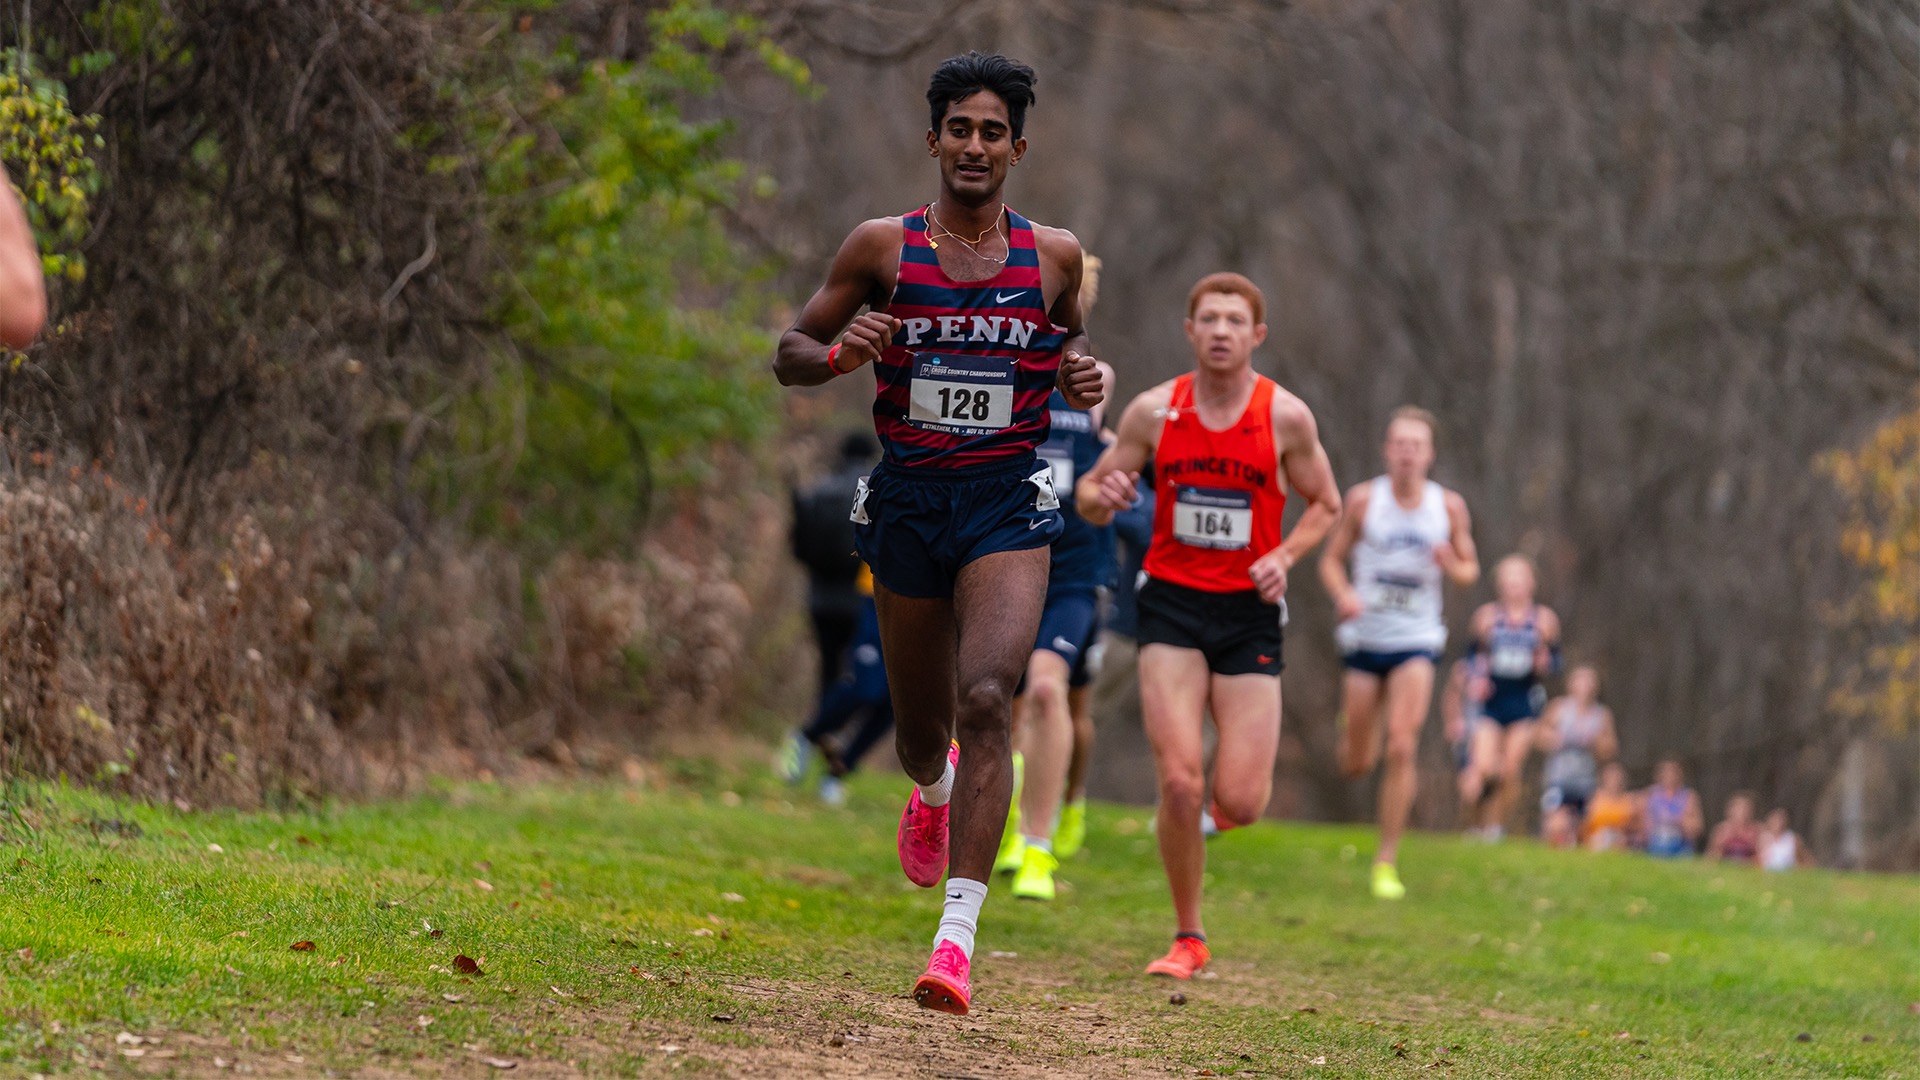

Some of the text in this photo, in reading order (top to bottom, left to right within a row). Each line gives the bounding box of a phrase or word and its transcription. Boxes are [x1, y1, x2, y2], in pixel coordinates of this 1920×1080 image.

[902, 316, 1038, 349] PENN
[931, 367, 947, 375] CROSS
[969, 370, 1007, 378] CHAMPIONSHIPS
[938, 387, 990, 421] 128
[1164, 456, 1268, 488] PRINCETON
[1194, 511, 1232, 536] 164
